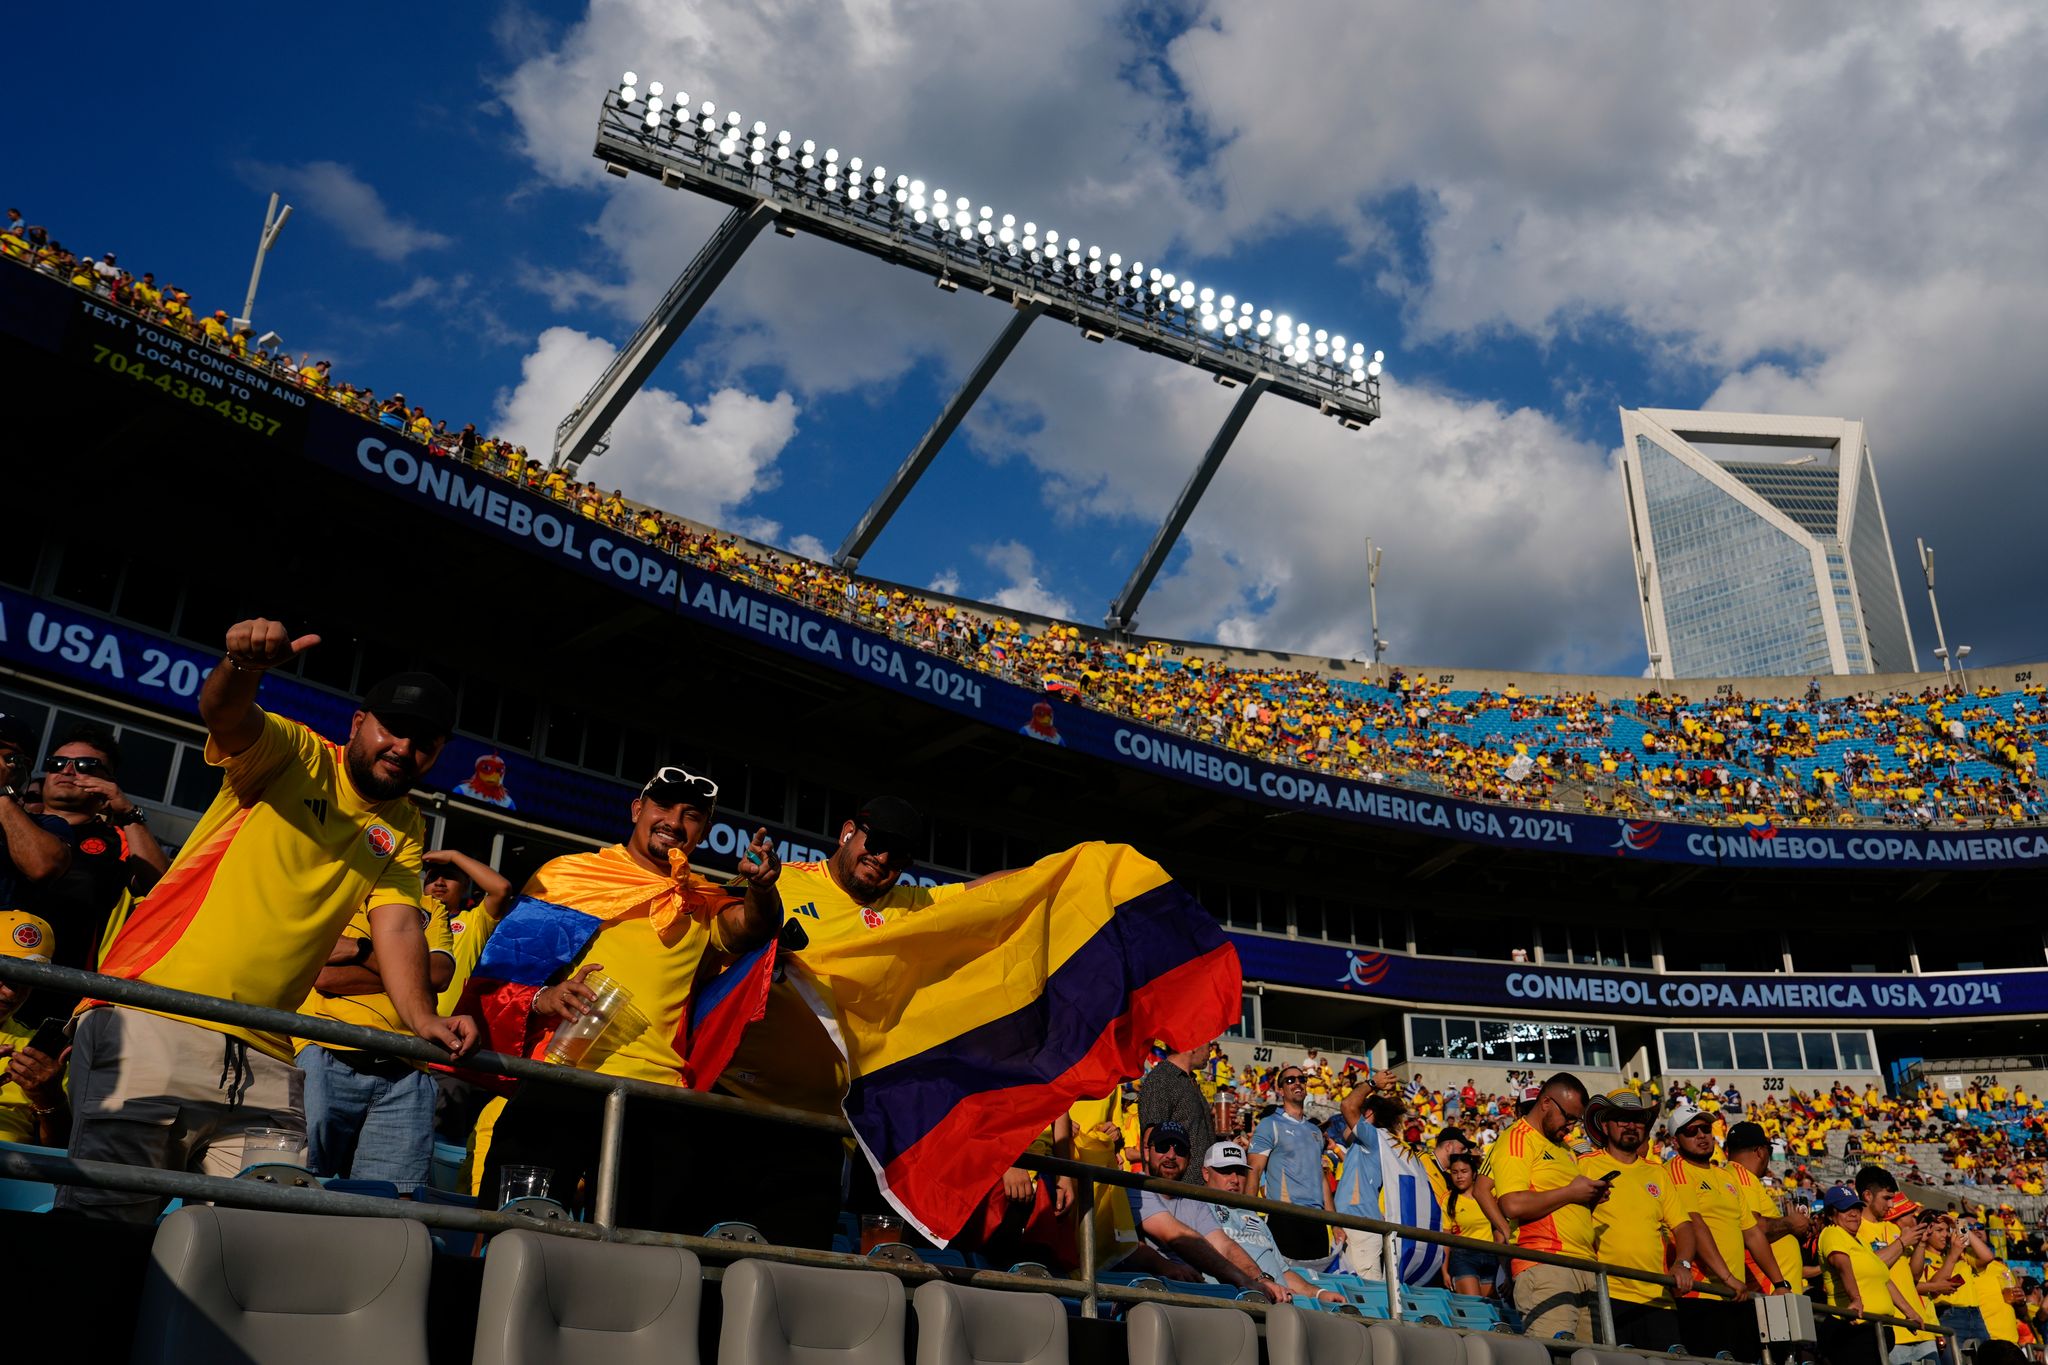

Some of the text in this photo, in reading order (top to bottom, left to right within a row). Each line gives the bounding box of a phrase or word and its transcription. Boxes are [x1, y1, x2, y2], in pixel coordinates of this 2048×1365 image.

[81, 300, 307, 408] TEXT YOUR CONCERN AND
[135, 343, 252, 401] LOCATION TO
[92, 343, 284, 437] 704-438-4357
[356, 437, 983, 708] CONMEBOL COPA AMERICA USA 2024
[27, 611, 125, 679] USA
[137, 648, 214, 702] 20
[2015, 671, 2032, 683] 524
[1114, 729, 1573, 844] CONMEBOL COPA AMERICA USA 2024
[1687, 833, 2048, 862] CONMEBOL COPA AMERICA
[1505, 972, 2001, 1009] CONMEBOL COPA AMERICA USA 2024
[1254, 1047, 1272, 1063] 321
[1763, 1077, 1785, 1091] 323
